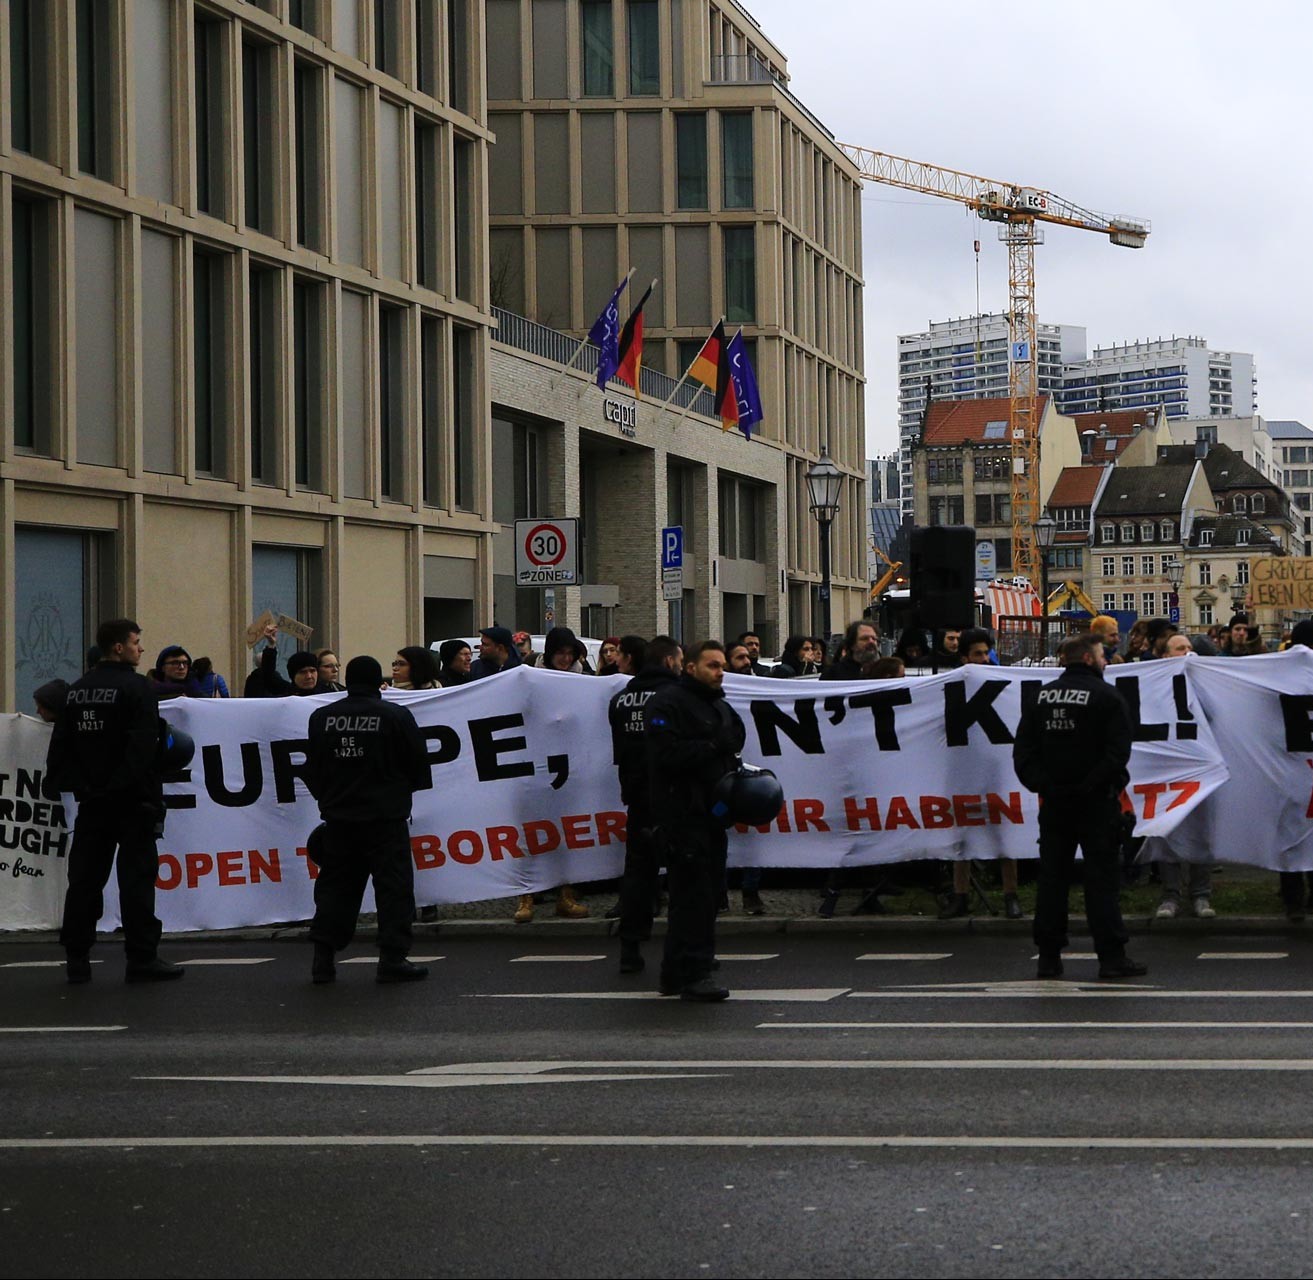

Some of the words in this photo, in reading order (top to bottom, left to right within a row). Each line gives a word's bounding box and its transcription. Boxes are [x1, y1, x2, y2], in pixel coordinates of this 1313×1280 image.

[1028, 196, 1046, 208] EC-B
[604, 399, 636, 432] capri
[533, 536, 558, 556] 30
[666, 533, 678, 563] P
[531, 570, 562, 582] ZONE
[66, 688, 118, 705] POLIZEI
[1037, 689, 1091, 706] POLIZEI
[83, 710, 96, 720] BE
[631, 711, 644, 721] BE
[1052, 708, 1067, 719] BE
[77, 720, 105, 731] 14217
[325, 715, 381, 732] POLIZEI
[624, 722, 645, 732] 1421
[341, 737, 356, 747] BE
[334, 747, 364, 758] 14216
[155, 848, 282, 891] OPEN
[845, 791, 1025, 831] HABEN
[13, 857, 44, 878] fear
